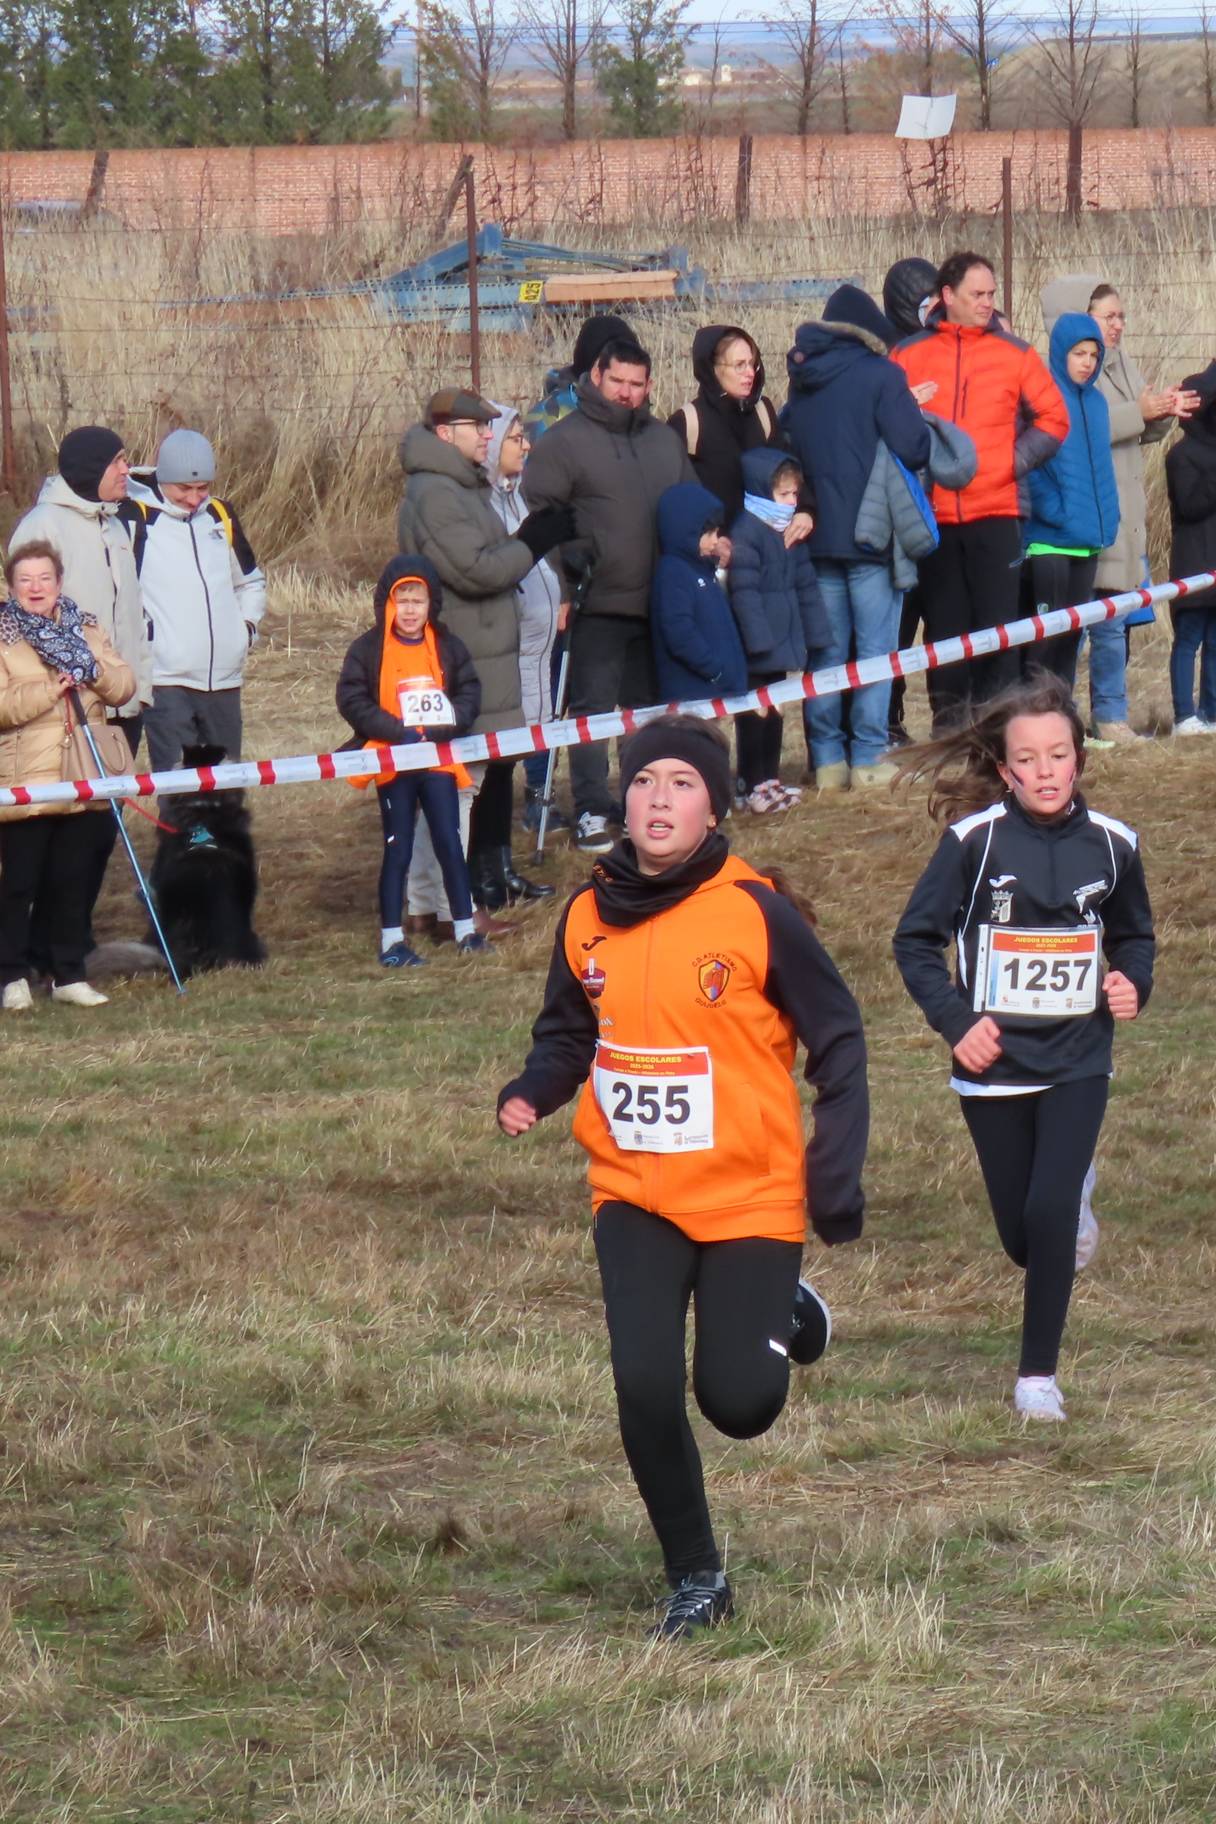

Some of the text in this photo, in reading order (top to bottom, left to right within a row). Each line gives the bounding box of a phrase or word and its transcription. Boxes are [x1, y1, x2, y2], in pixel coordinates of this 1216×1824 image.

[408, 693, 443, 712] 263
[1004, 958, 1092, 992] 1257
[609, 1051, 682, 1063] JUEGOS ESCOLARES
[612, 1081, 691, 1125] 255
